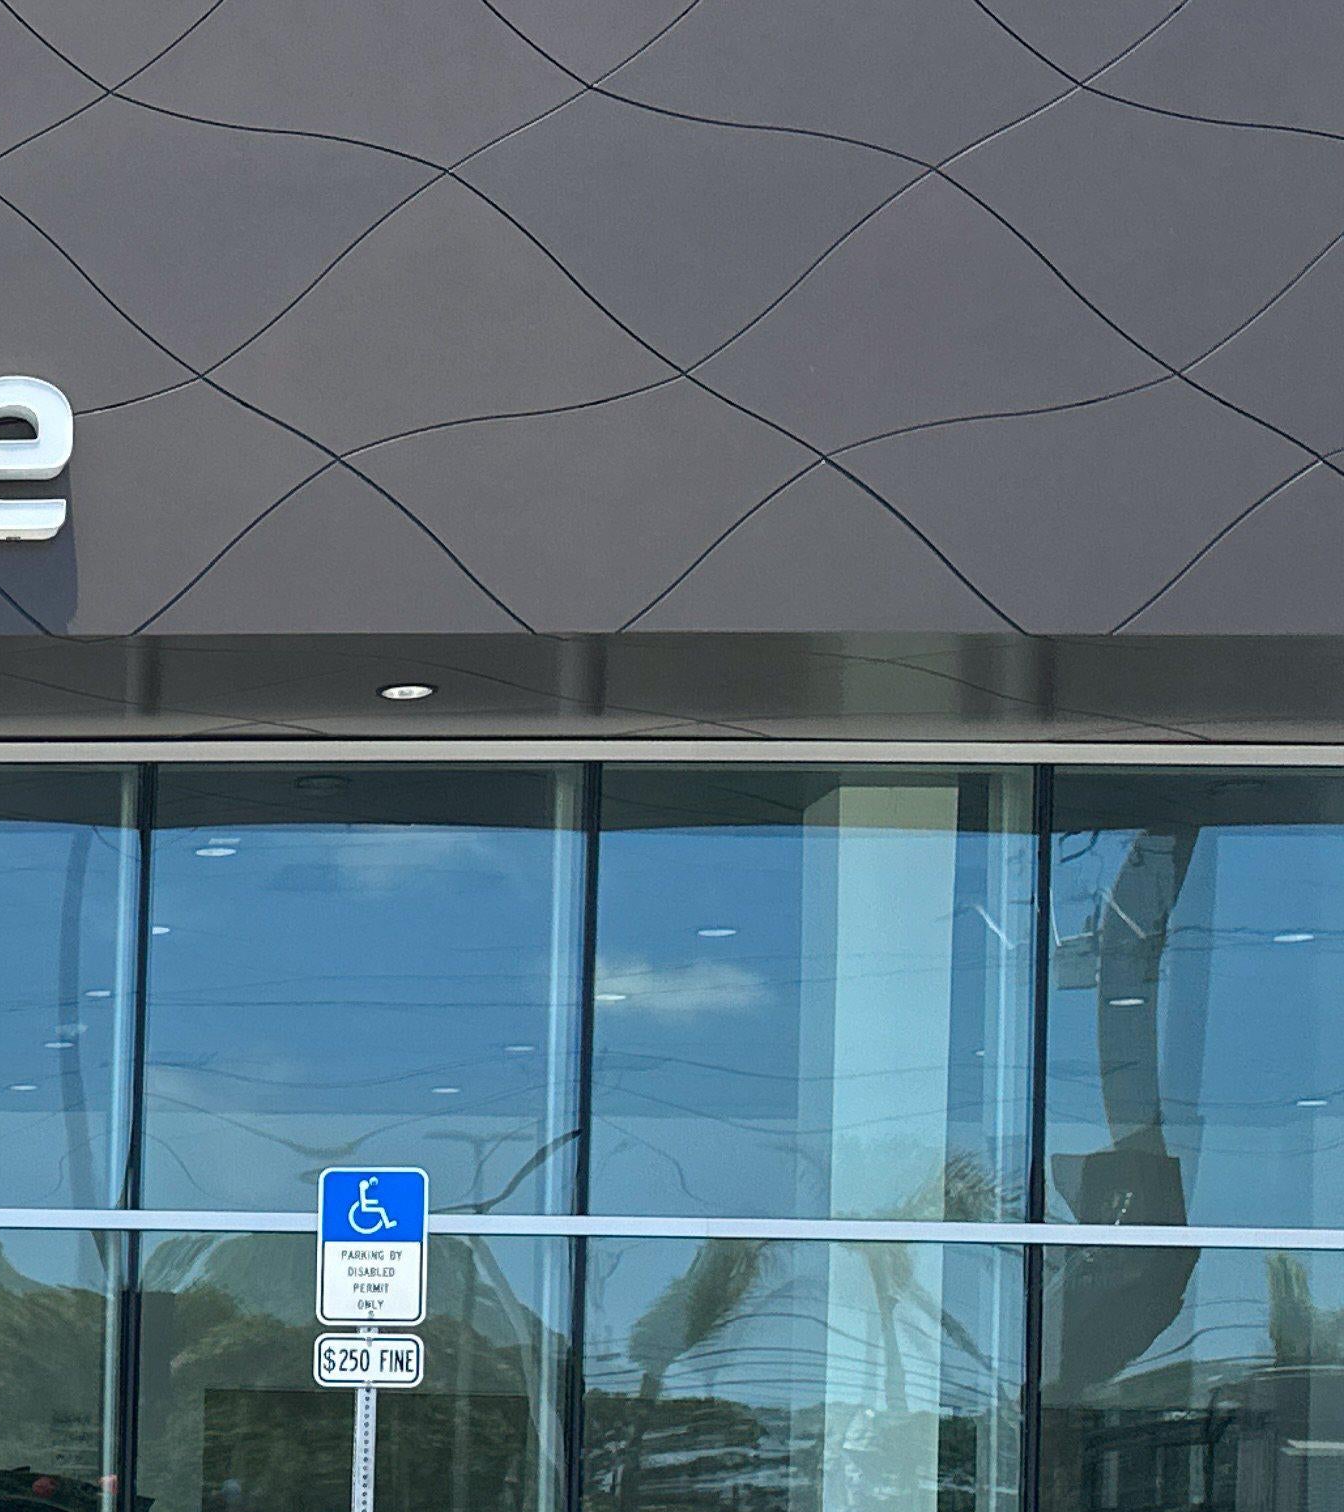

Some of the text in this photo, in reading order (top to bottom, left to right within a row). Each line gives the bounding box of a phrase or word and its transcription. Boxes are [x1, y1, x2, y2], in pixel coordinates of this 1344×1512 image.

[341, 1250, 402, 1260] PARKING BY
[348, 1267, 395, 1277] DISABLED
[353, 1284, 389, 1293] PERMIT
[357, 1300, 384, 1310] ONLY
[323, 1346, 414, 1373] $250 FINE
